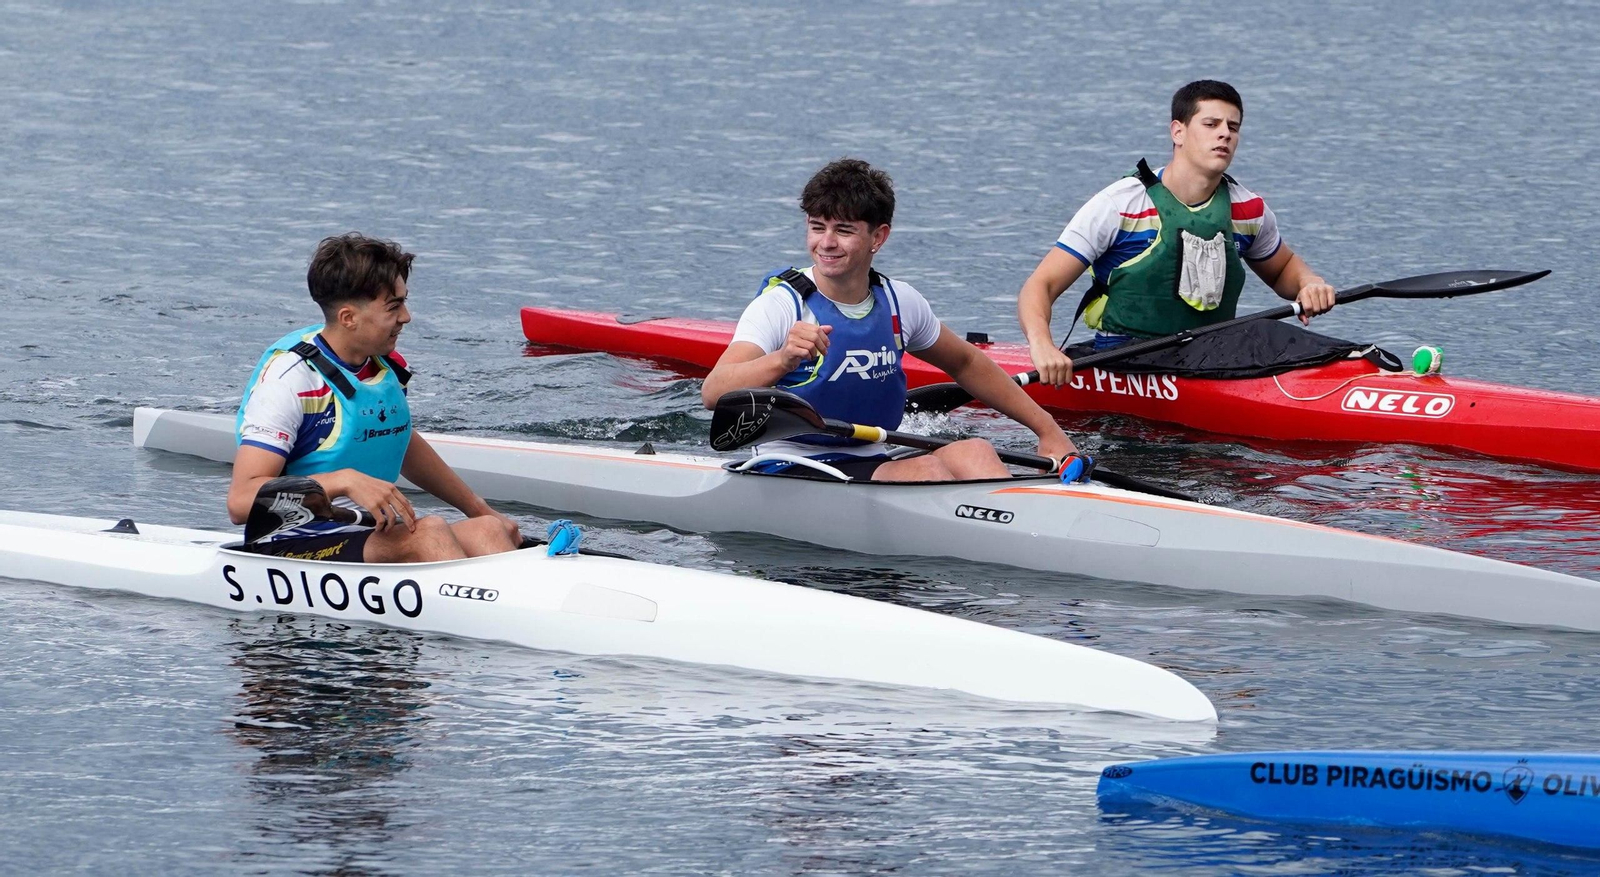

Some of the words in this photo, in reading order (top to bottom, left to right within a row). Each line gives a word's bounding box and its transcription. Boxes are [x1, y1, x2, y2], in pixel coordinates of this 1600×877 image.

[1346, 390, 1451, 415] NELO
[957, 505, 1013, 523] NELO
[222, 564, 423, 618] S.DIOGO
[440, 584, 498, 601] NELO
[1250, 762, 1318, 786] CLUB
[1326, 764, 1492, 793] PIRAGÜISMO
